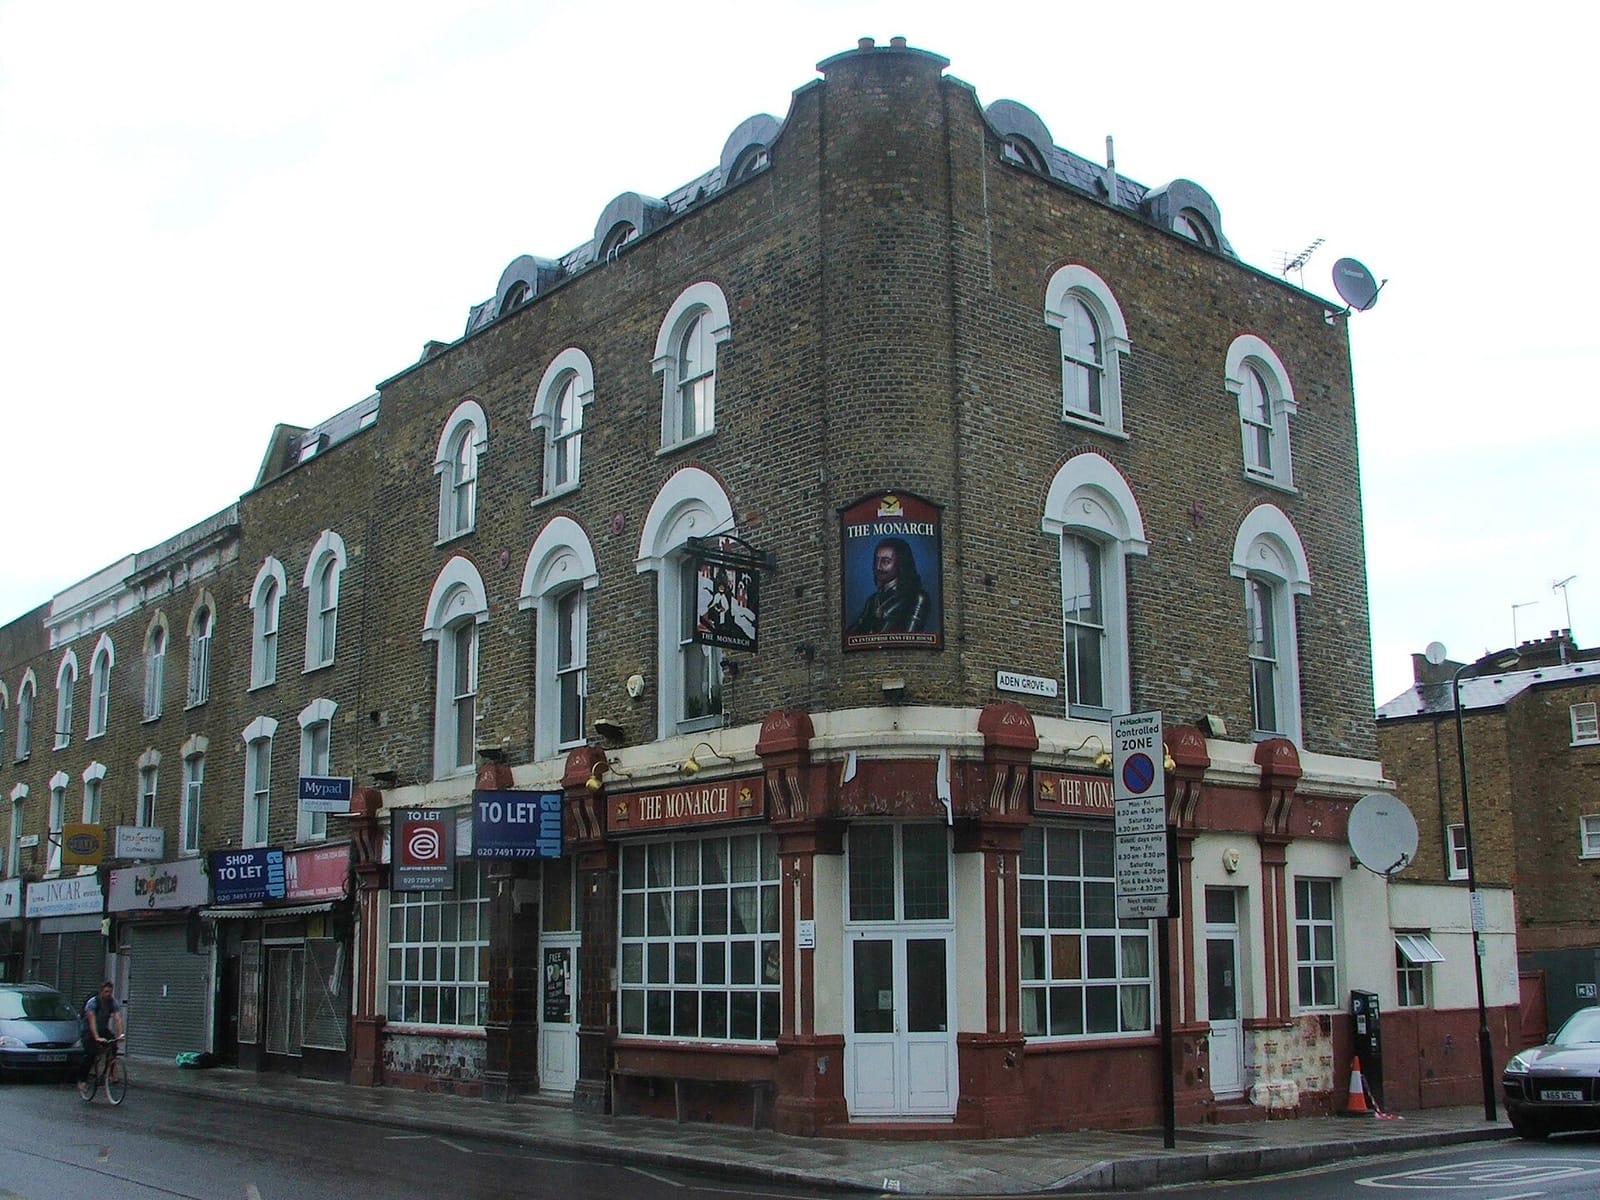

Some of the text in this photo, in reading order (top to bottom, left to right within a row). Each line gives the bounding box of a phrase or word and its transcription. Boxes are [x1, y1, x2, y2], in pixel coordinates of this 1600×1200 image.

[847, 522, 934, 538] THE MONARCH
[701, 632, 750, 648] THE MONARCH
[999, 674, 1020, 688] ADEN
[1021, 678, 1045, 692] GROVE
[1126, 716, 1154, 726] Hackney
[1115, 724, 1160, 738] Controlled
[1121, 737, 1153, 751] ZONE
[305, 781, 342, 796] Mypad
[1060, 778, 1082, 806] THE
[639, 787, 729, 821] THE MONARCH
[407, 811, 441, 822] TO LET
[479, 802, 537, 824] TO LET
[1128, 816, 1153, 825] Saturday
[477, 848, 493, 857] 020
[516, 848, 536, 857] 7777
[225, 854, 254, 866] SHOP
[1129, 860, 1154, 869] Saturday
[218, 865, 262, 881] TO LET
